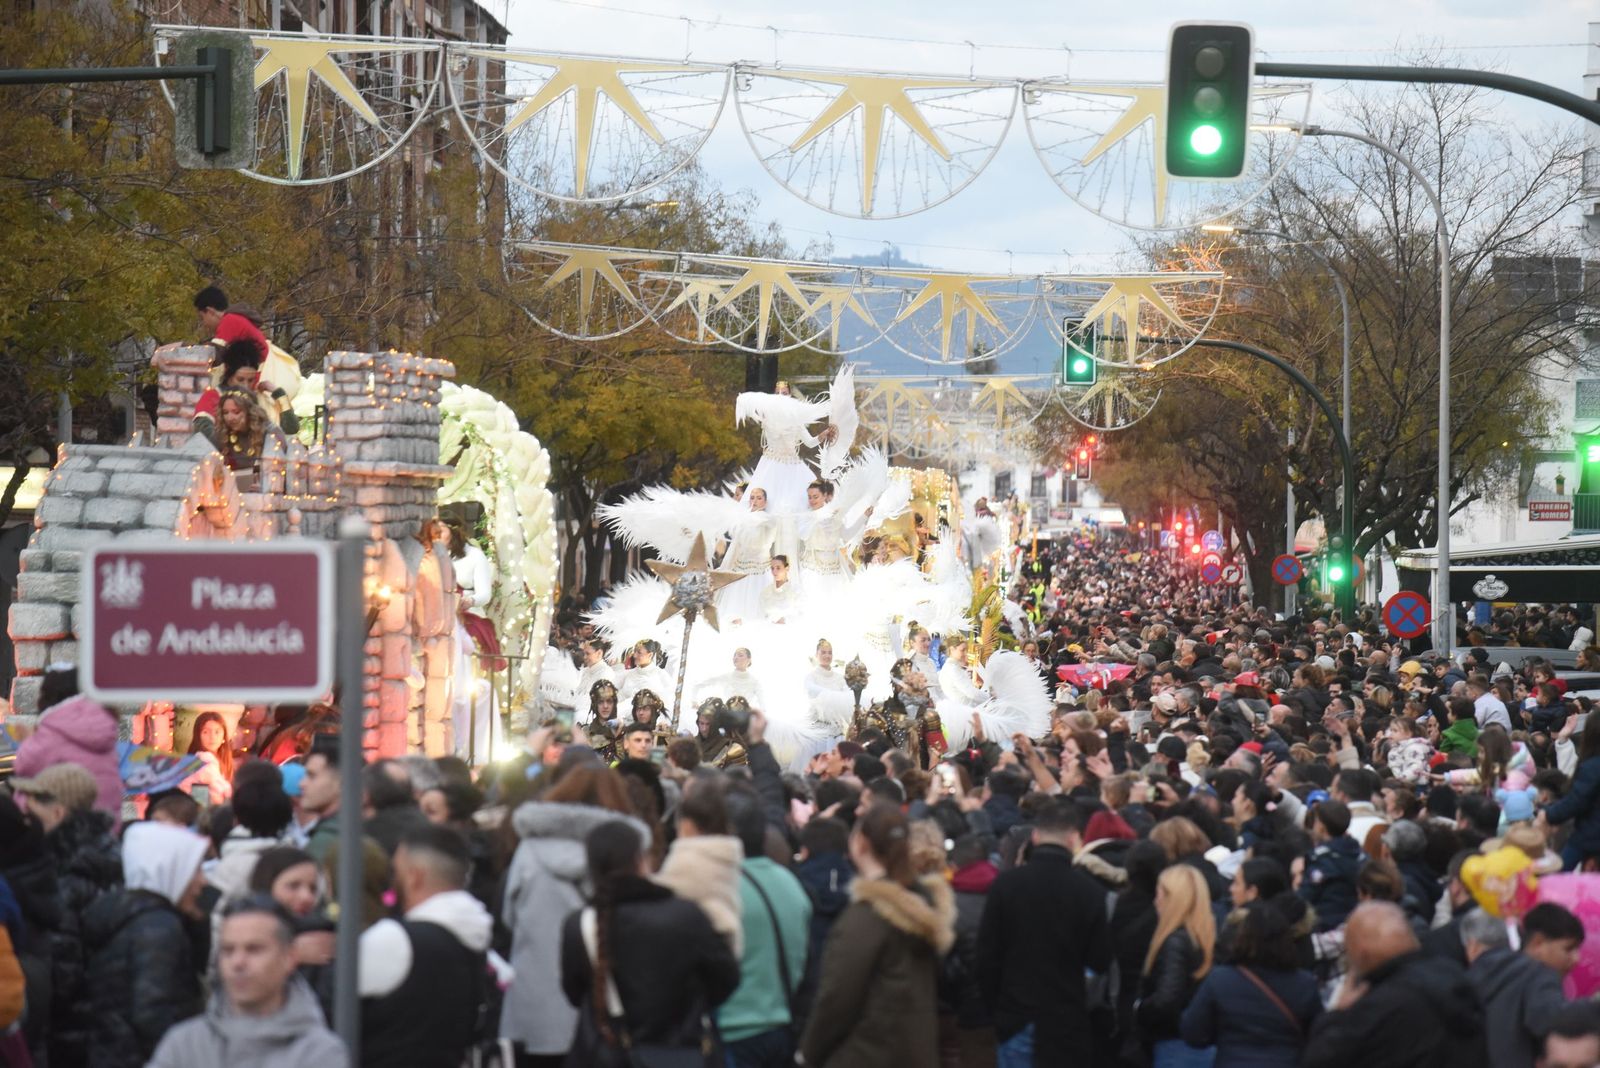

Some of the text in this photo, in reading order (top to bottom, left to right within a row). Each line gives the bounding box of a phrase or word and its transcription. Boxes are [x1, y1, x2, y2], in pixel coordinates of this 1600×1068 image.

[191, 576, 276, 610] Plaza
[110, 620, 305, 656] de Andalucía
